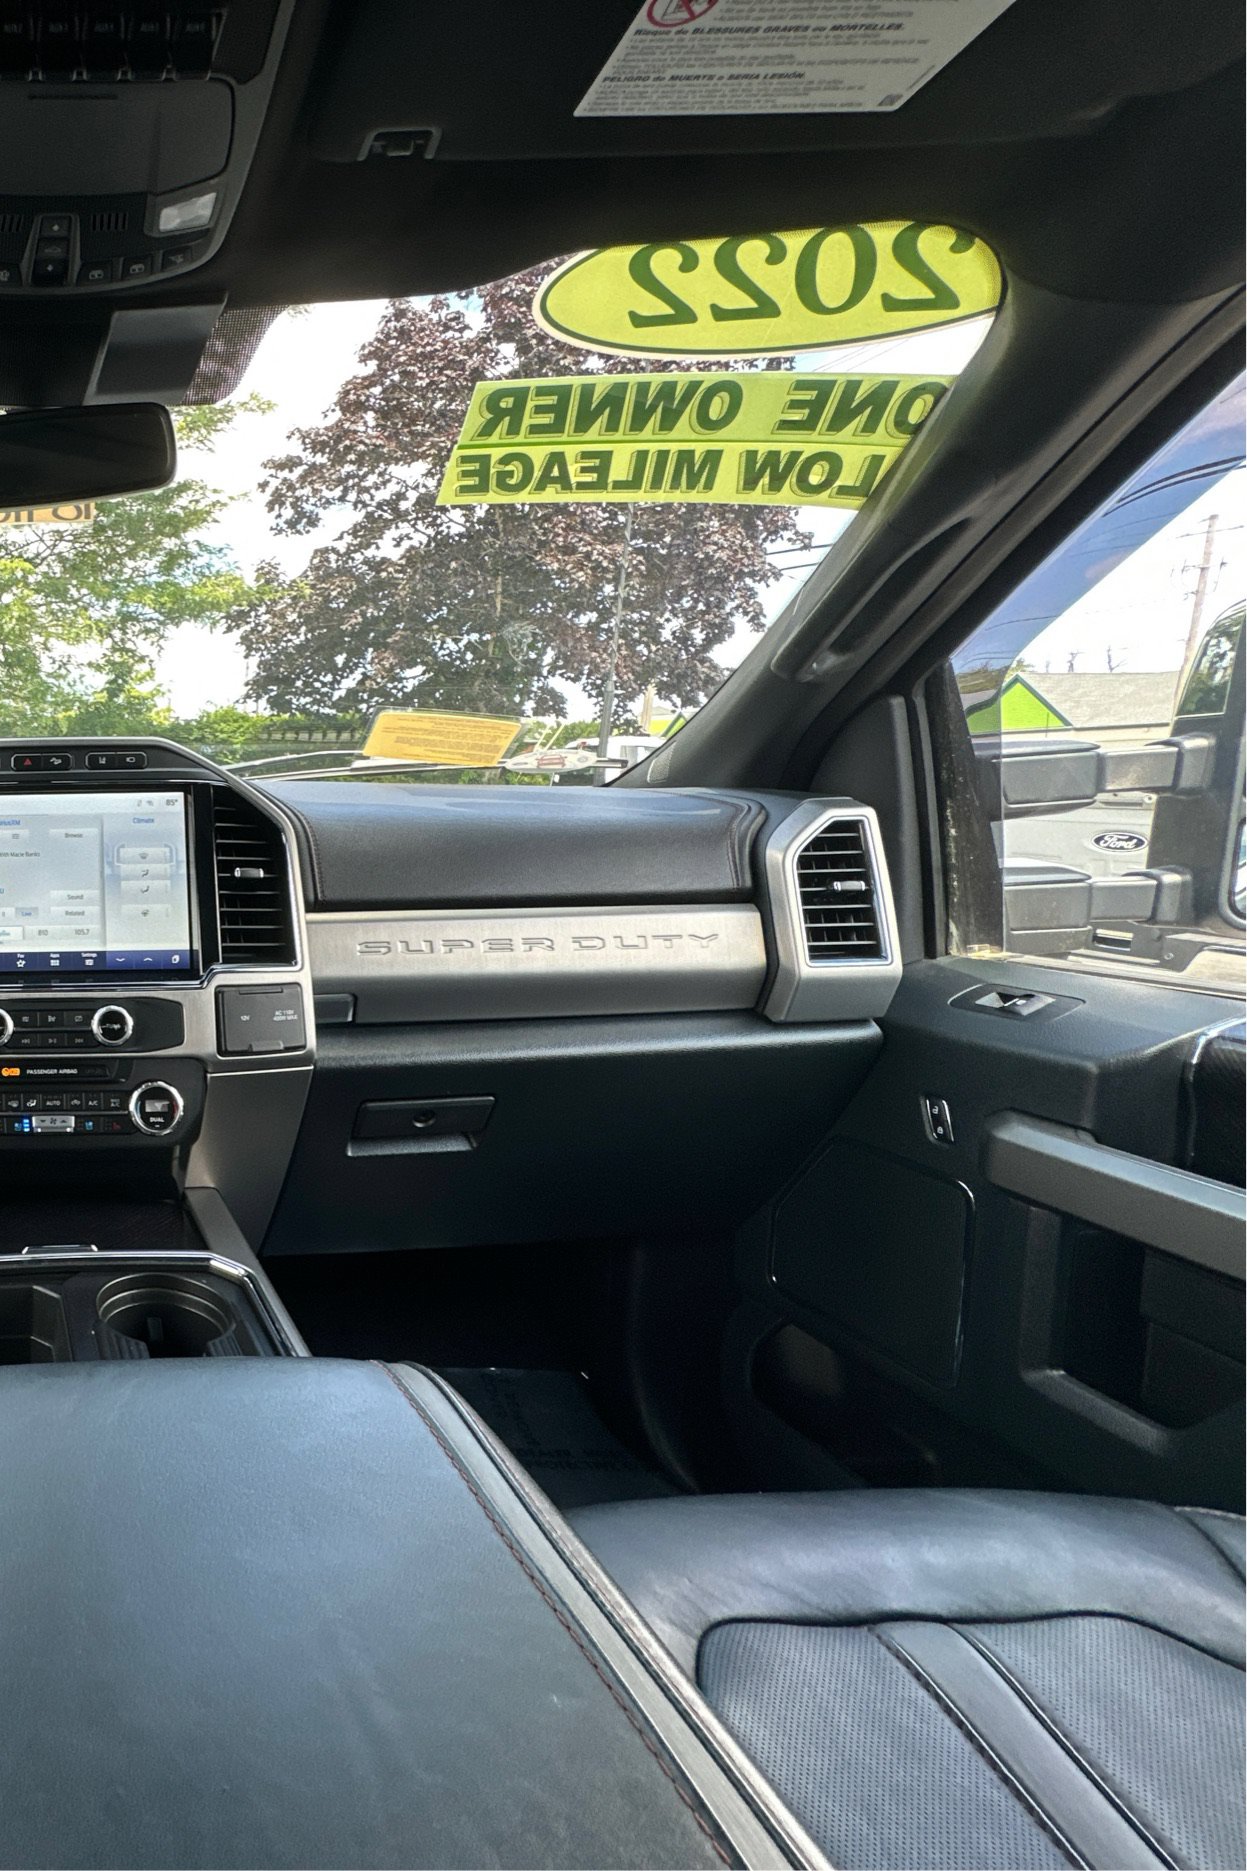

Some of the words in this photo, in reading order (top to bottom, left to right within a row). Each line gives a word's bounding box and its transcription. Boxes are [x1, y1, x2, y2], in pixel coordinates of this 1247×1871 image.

[692, 26, 760, 36] BLESSURES
[763, 25, 810, 34] GRAVES
[602, 74, 650, 83] PELIGRO
[668, 73, 715, 82] MUERTE
[727, 73, 760, 81] SERIA
[1099, 834, 1138, 849] Ford
[356, 936, 556, 956] SUPER
[572, 932, 719, 952] DUTY
